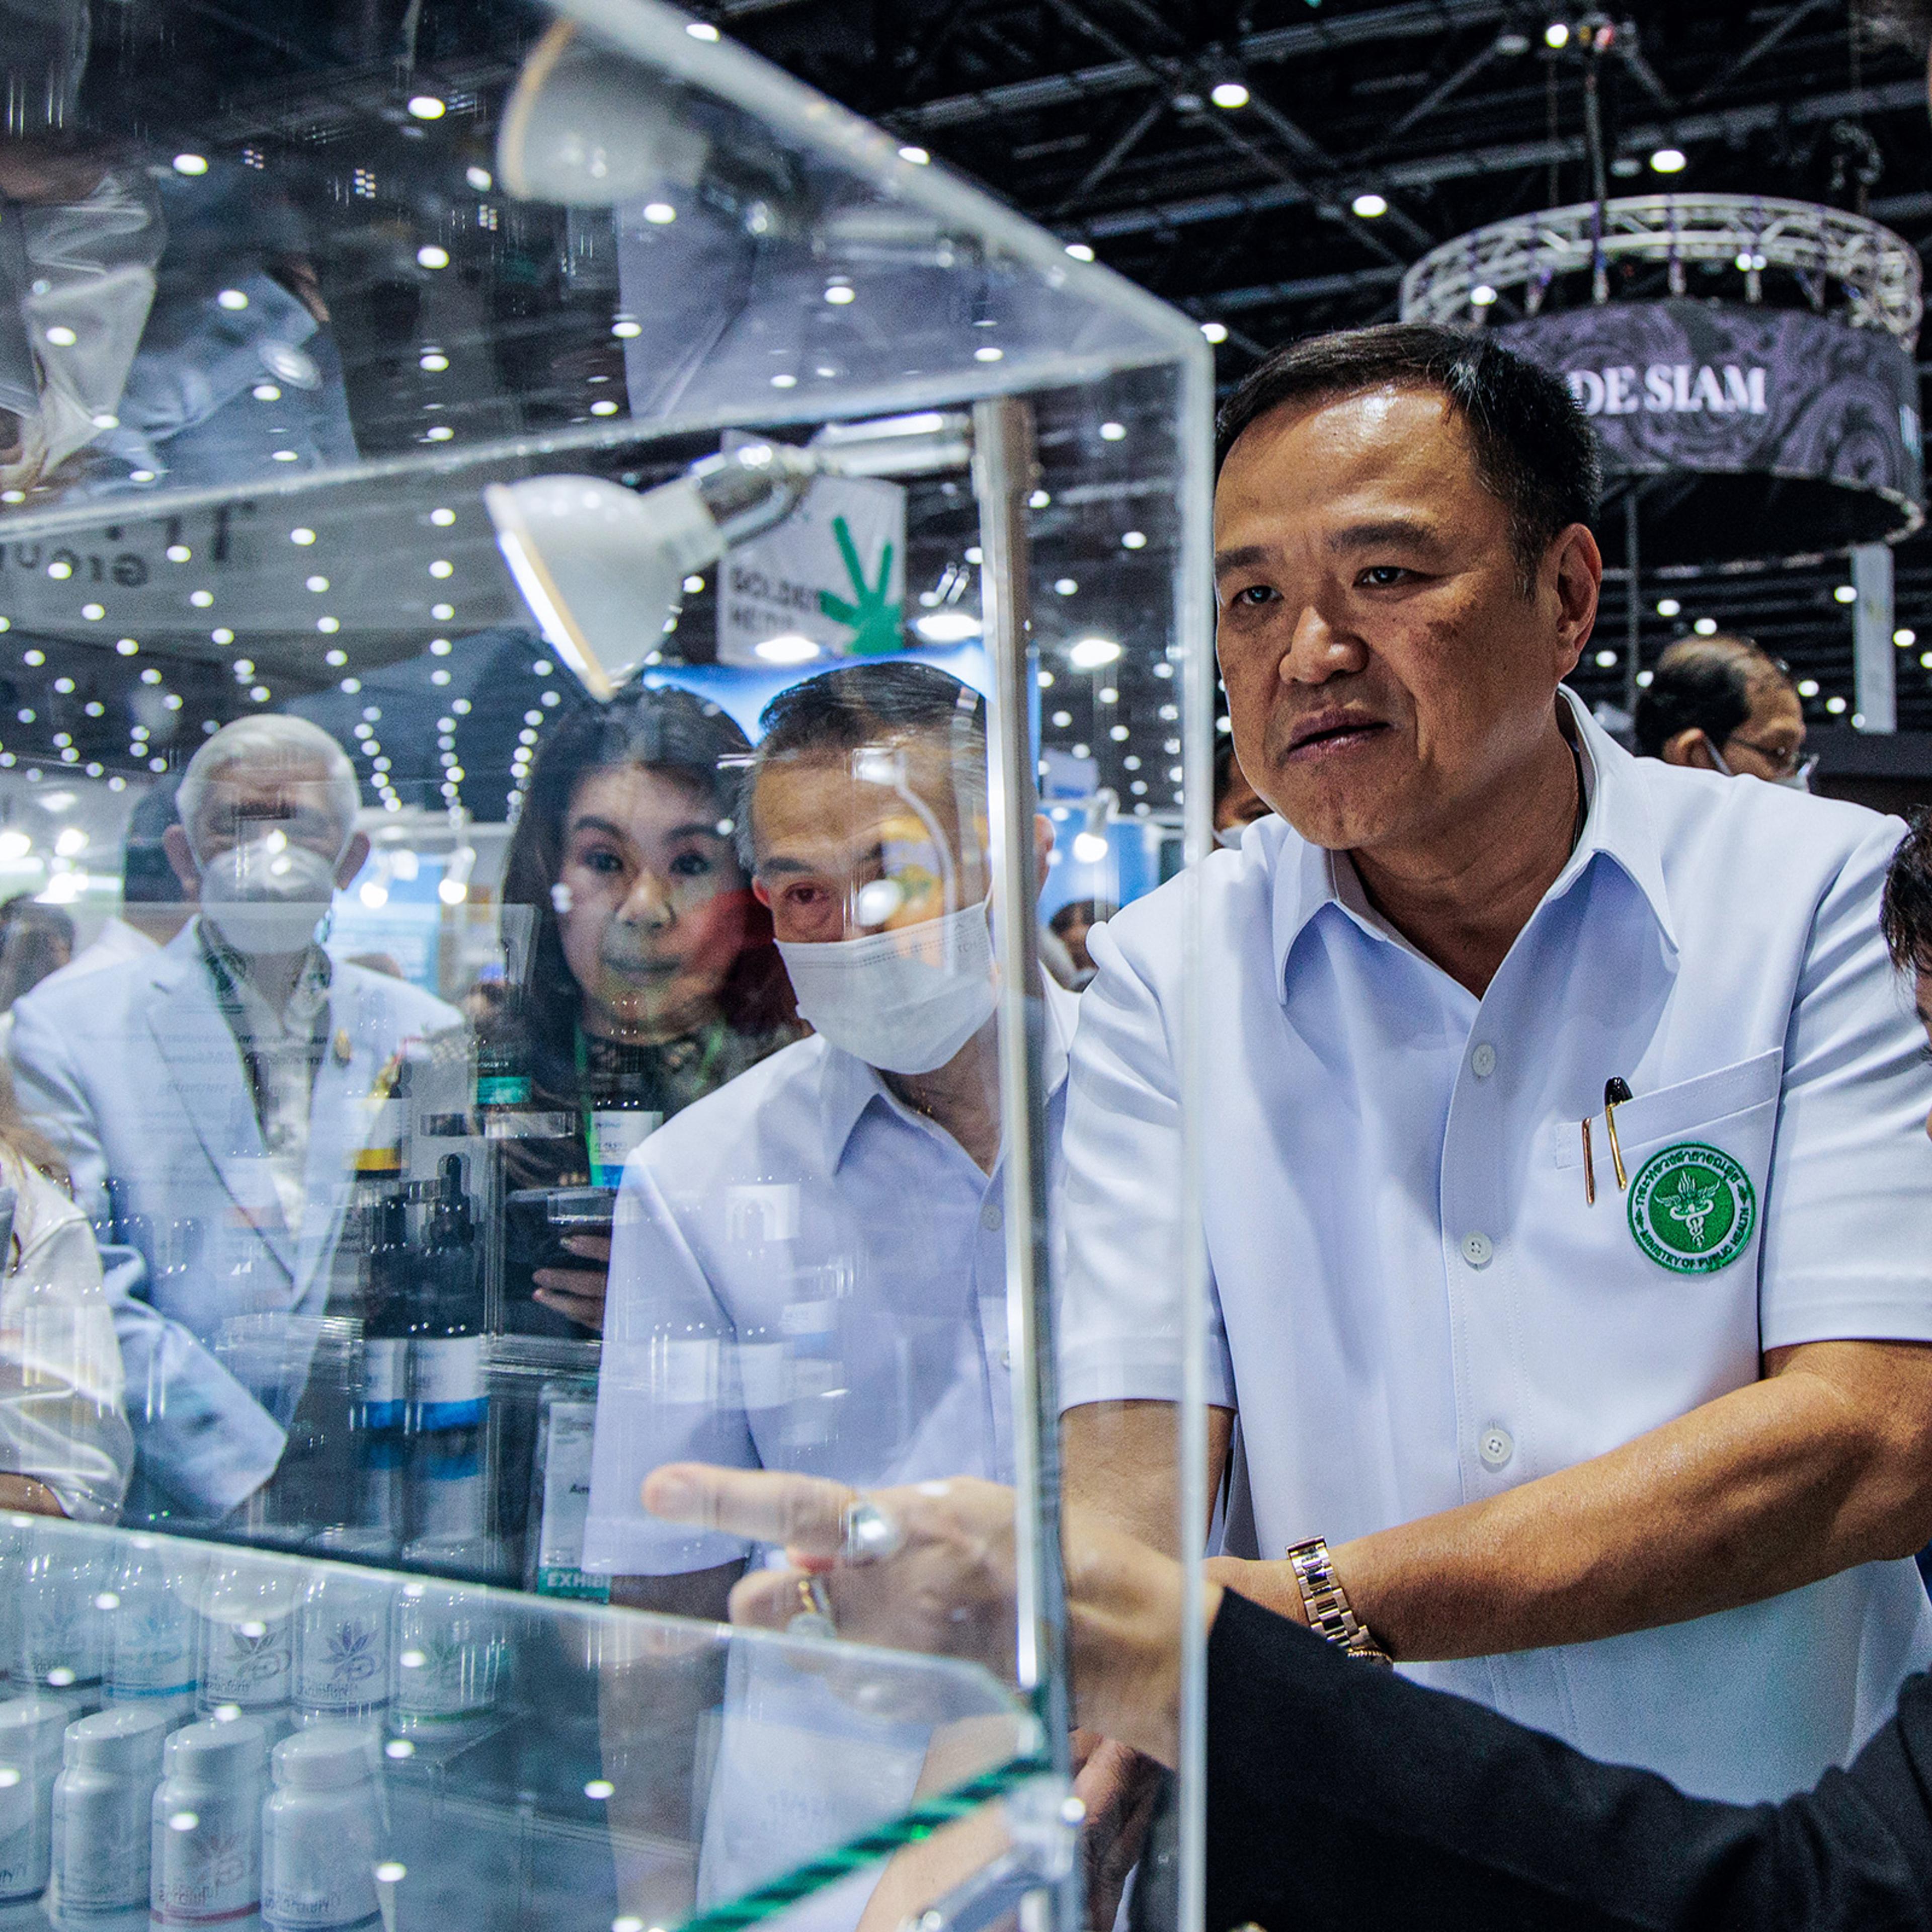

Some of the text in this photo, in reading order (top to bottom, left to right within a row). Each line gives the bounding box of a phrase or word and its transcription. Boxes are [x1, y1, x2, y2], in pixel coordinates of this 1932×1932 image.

[1643, 363, 1767, 415] SIAM
[1639, 1206, 1749, 1267] MINISTRY OF PUBLIC HEALTH
